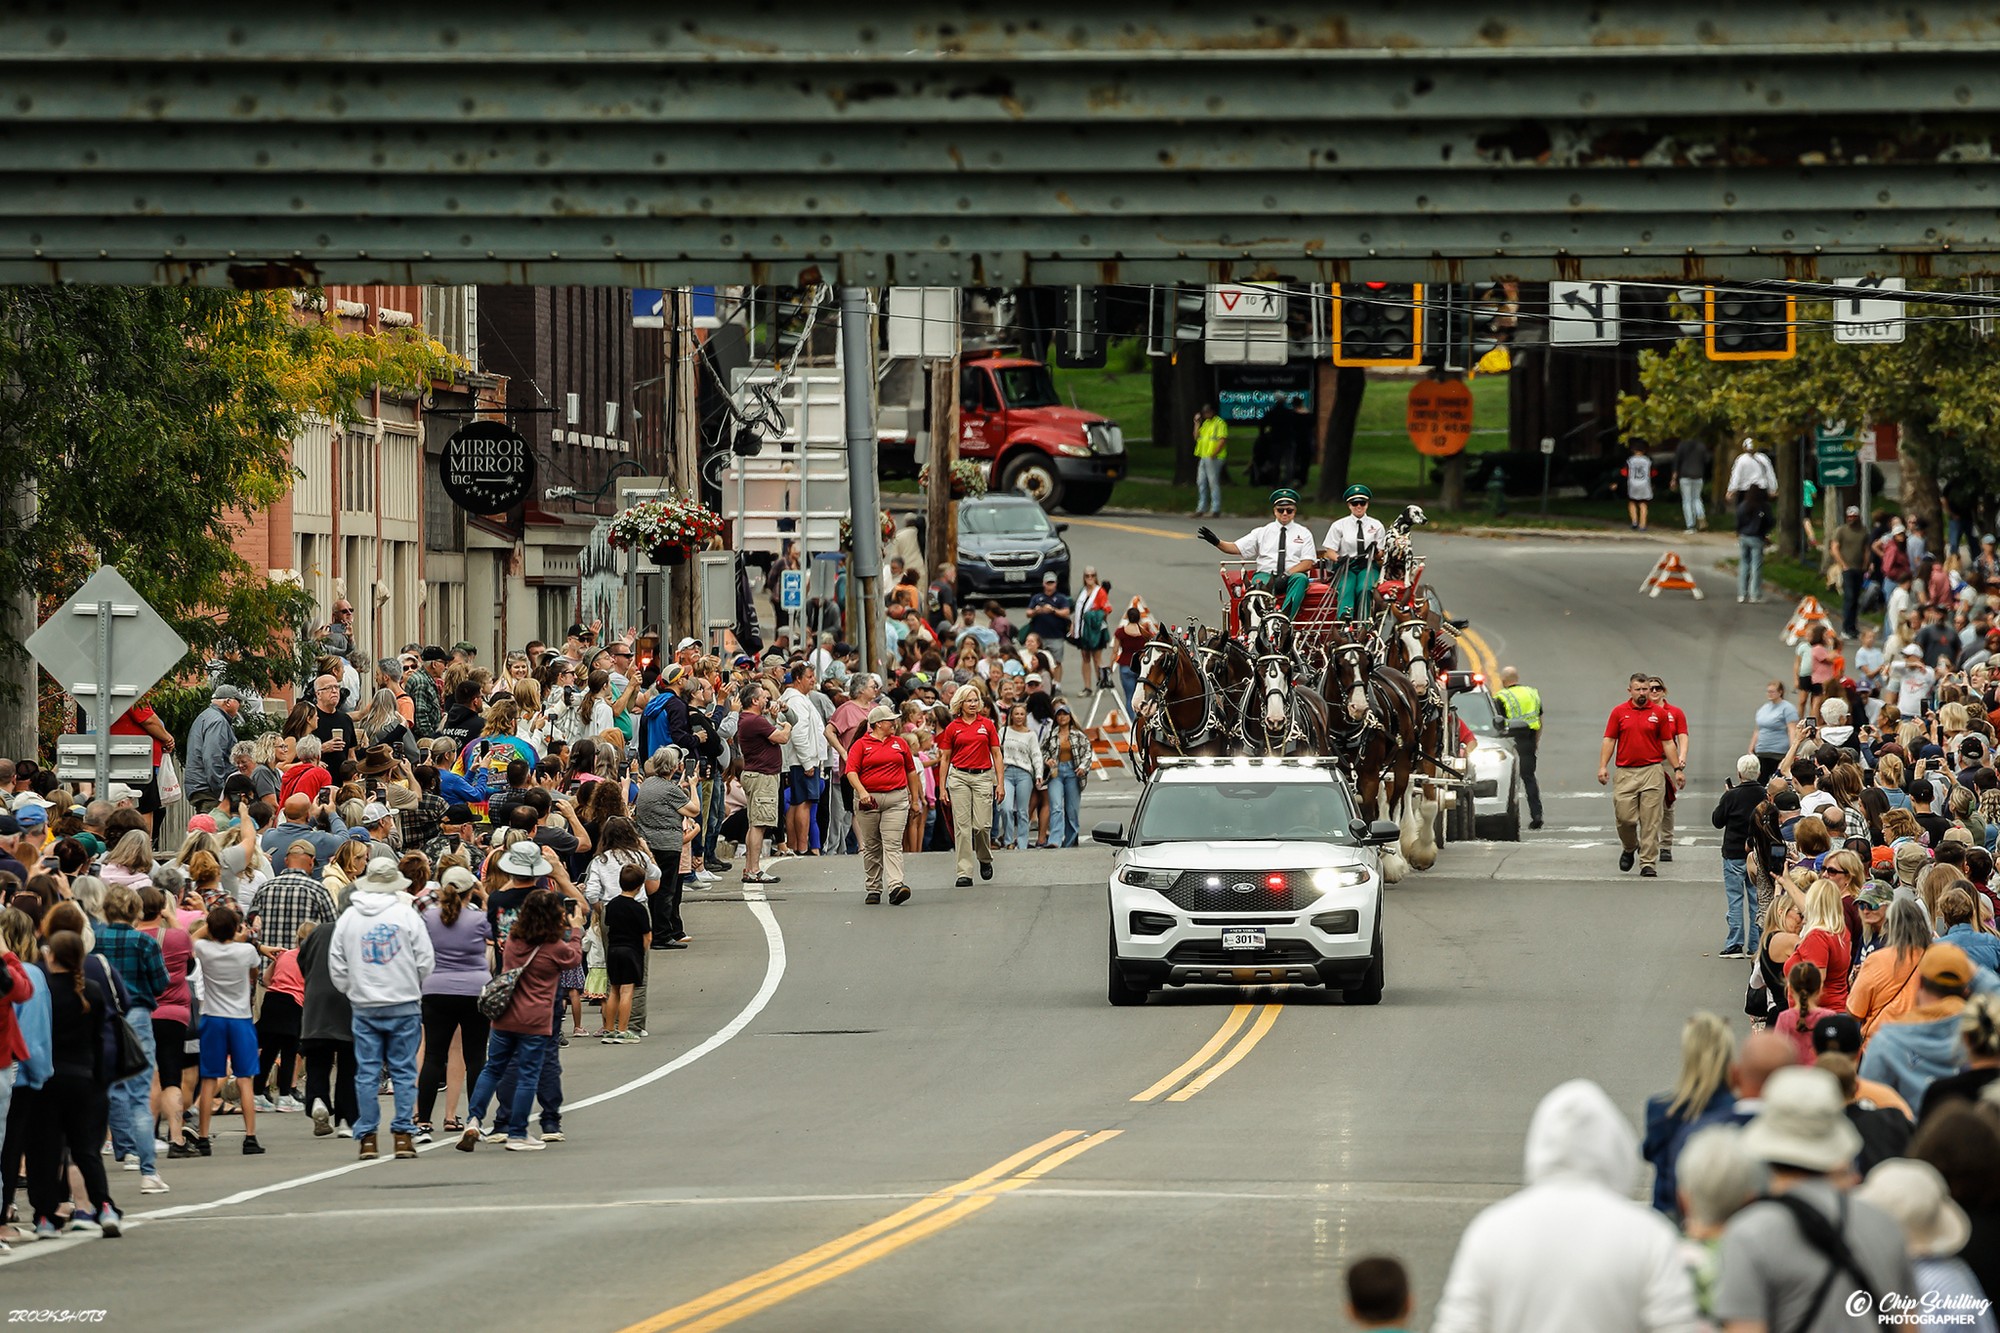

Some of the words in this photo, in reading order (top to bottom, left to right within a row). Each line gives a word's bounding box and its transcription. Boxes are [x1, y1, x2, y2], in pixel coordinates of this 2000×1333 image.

[1245, 295, 1256, 305] TO
[1845, 323, 1891, 336] ONLY
[450, 439, 524, 455] MIRROR
[450, 456, 524, 472] MIRROR
[450, 472, 474, 485] inc.
[1235, 935, 1252, 944] 301
